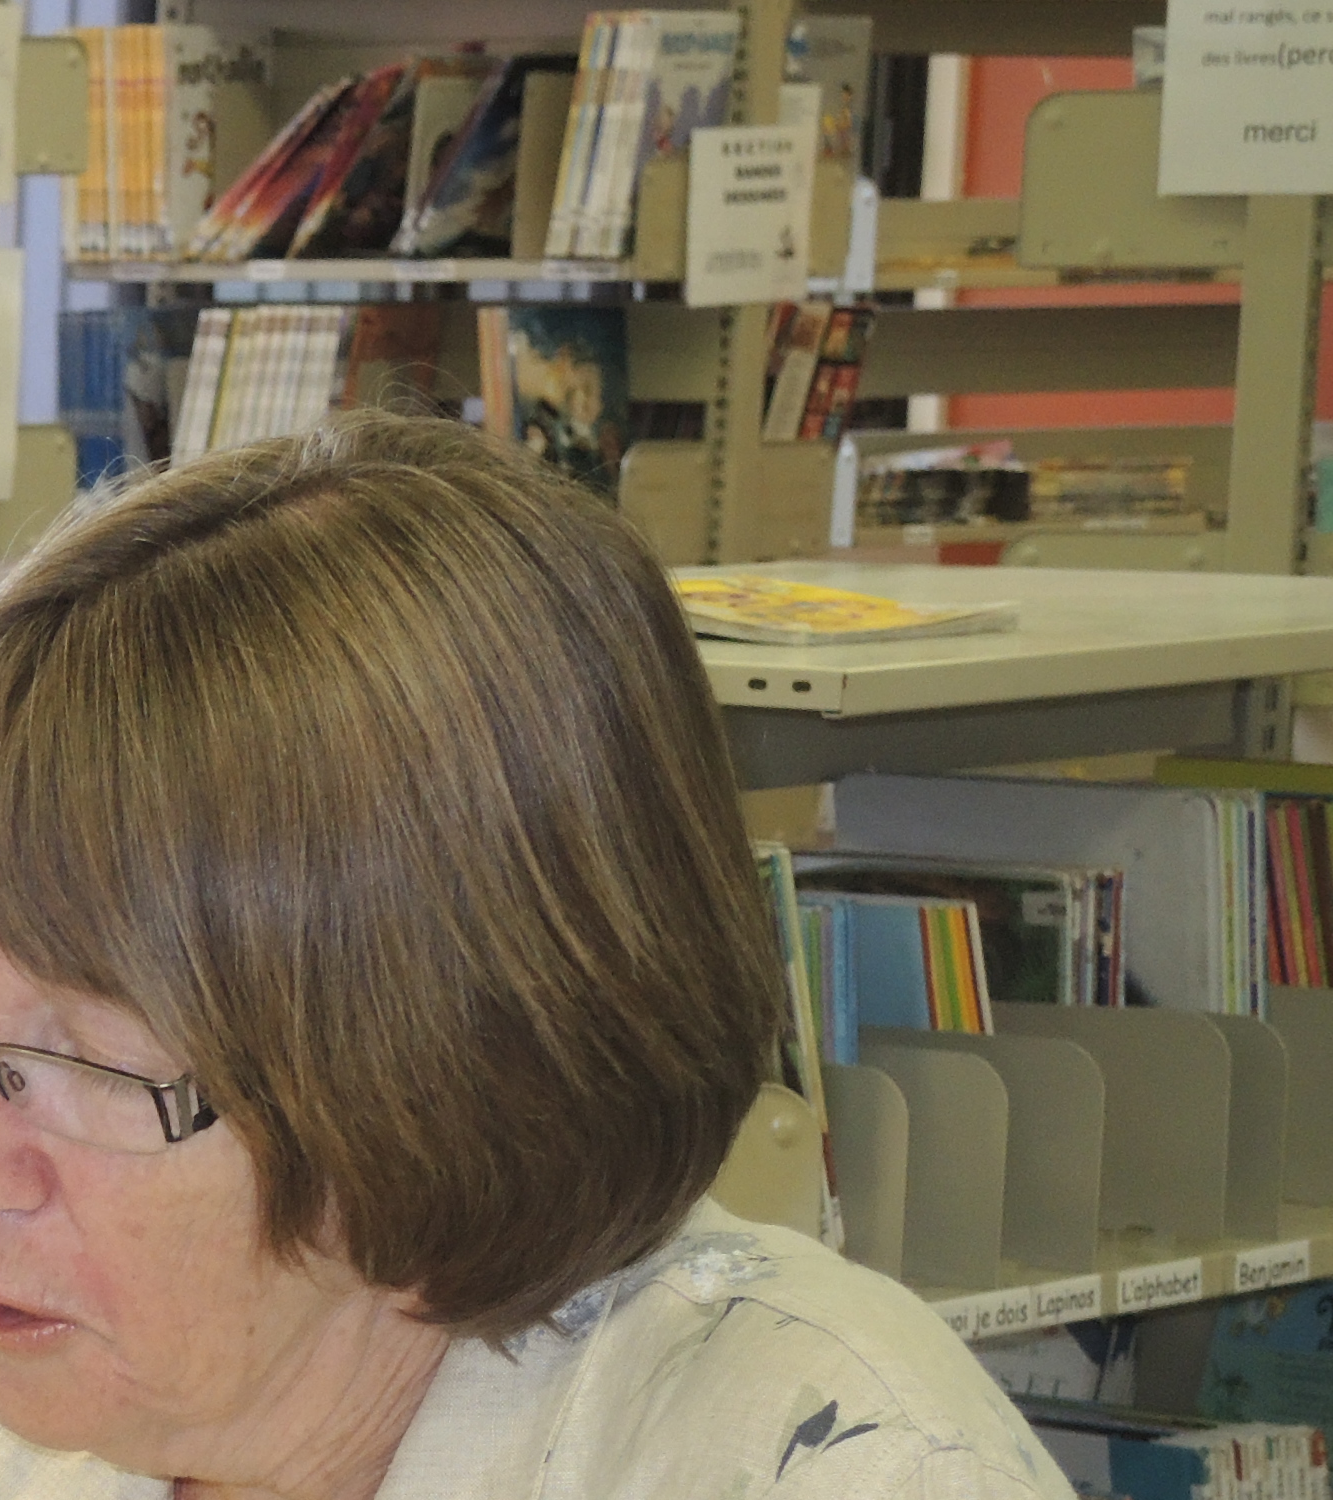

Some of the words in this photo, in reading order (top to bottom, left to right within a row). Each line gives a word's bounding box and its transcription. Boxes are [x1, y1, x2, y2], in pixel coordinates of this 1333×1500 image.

[1203, 9, 1233, 25] mal
[1243, 118, 1317, 143] merci
[1120, 1272, 1200, 1311] L'alphabet
[1238, 1256, 1307, 1294] Benjamin
[973, 1308, 991, 1337] je
[995, 1300, 1028, 1327] dois
